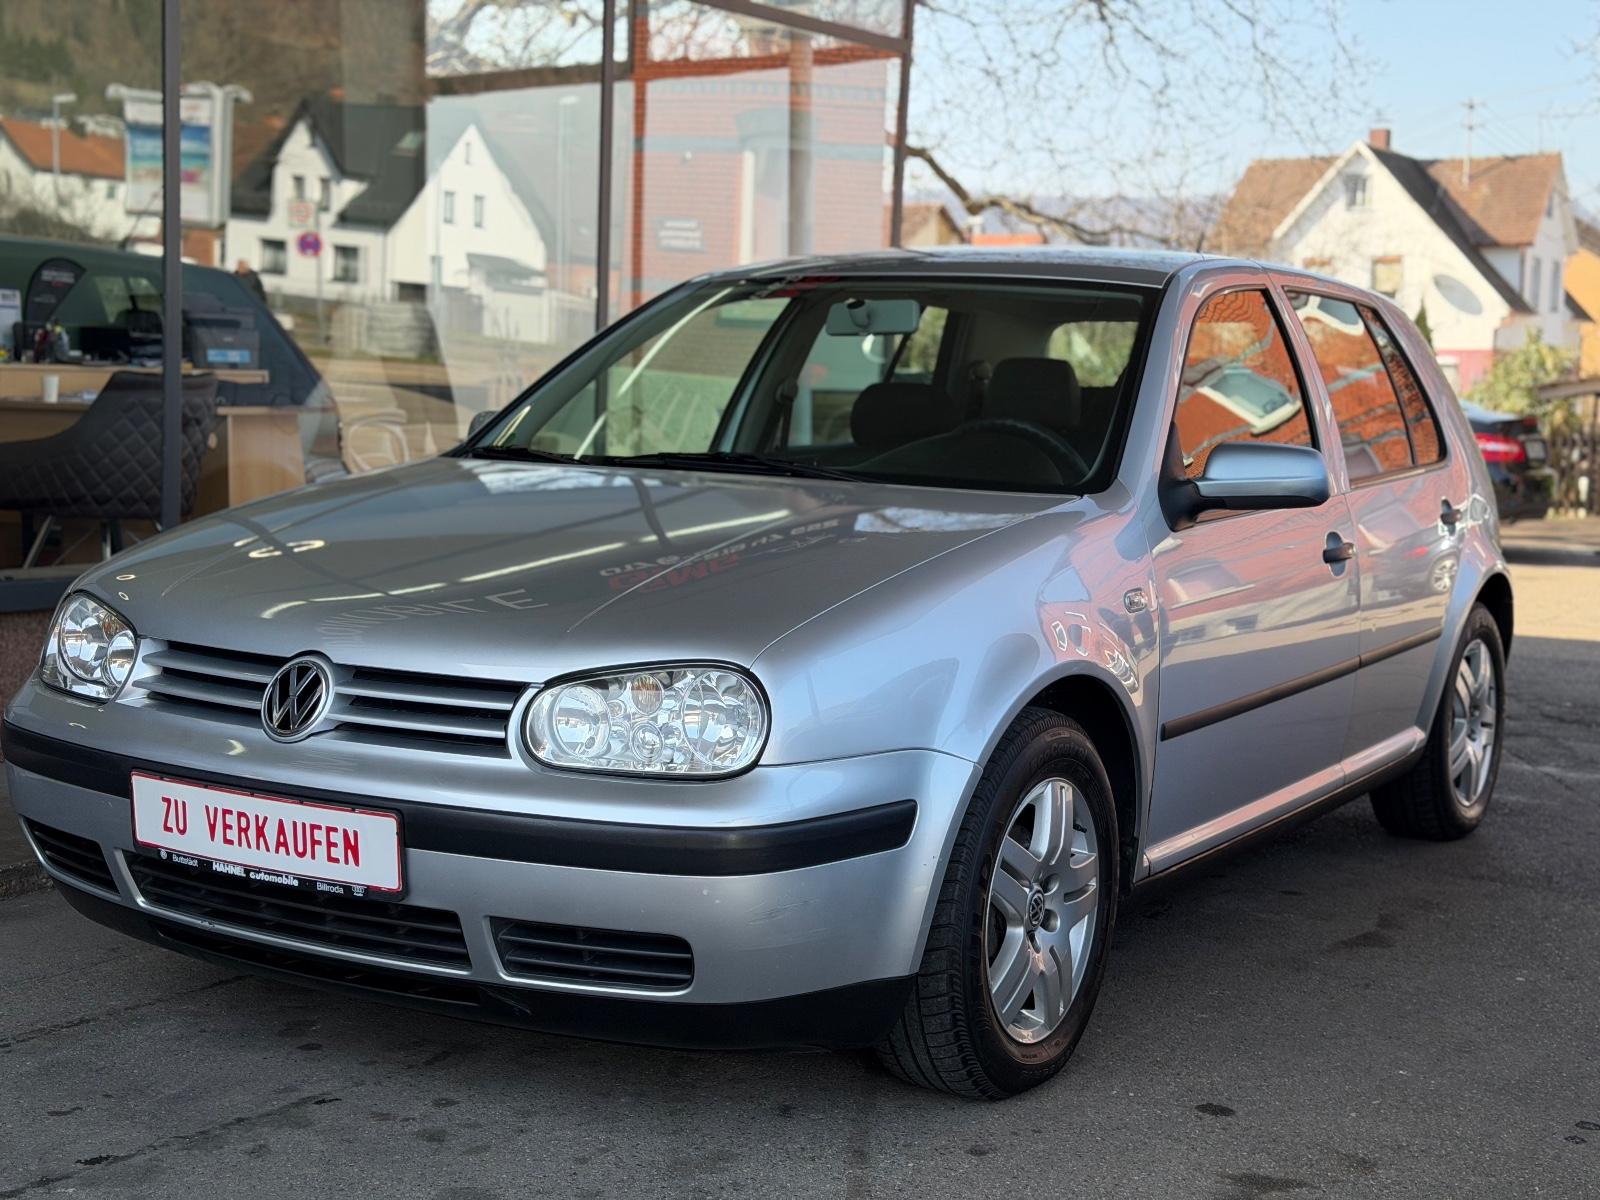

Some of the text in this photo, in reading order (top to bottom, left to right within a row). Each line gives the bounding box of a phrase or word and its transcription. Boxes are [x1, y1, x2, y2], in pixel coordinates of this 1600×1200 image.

[160, 795, 361, 868] ZU VERKAUFEN
[249, 871, 299, 887] automobile
[316, 881, 344, 895] Billroda
